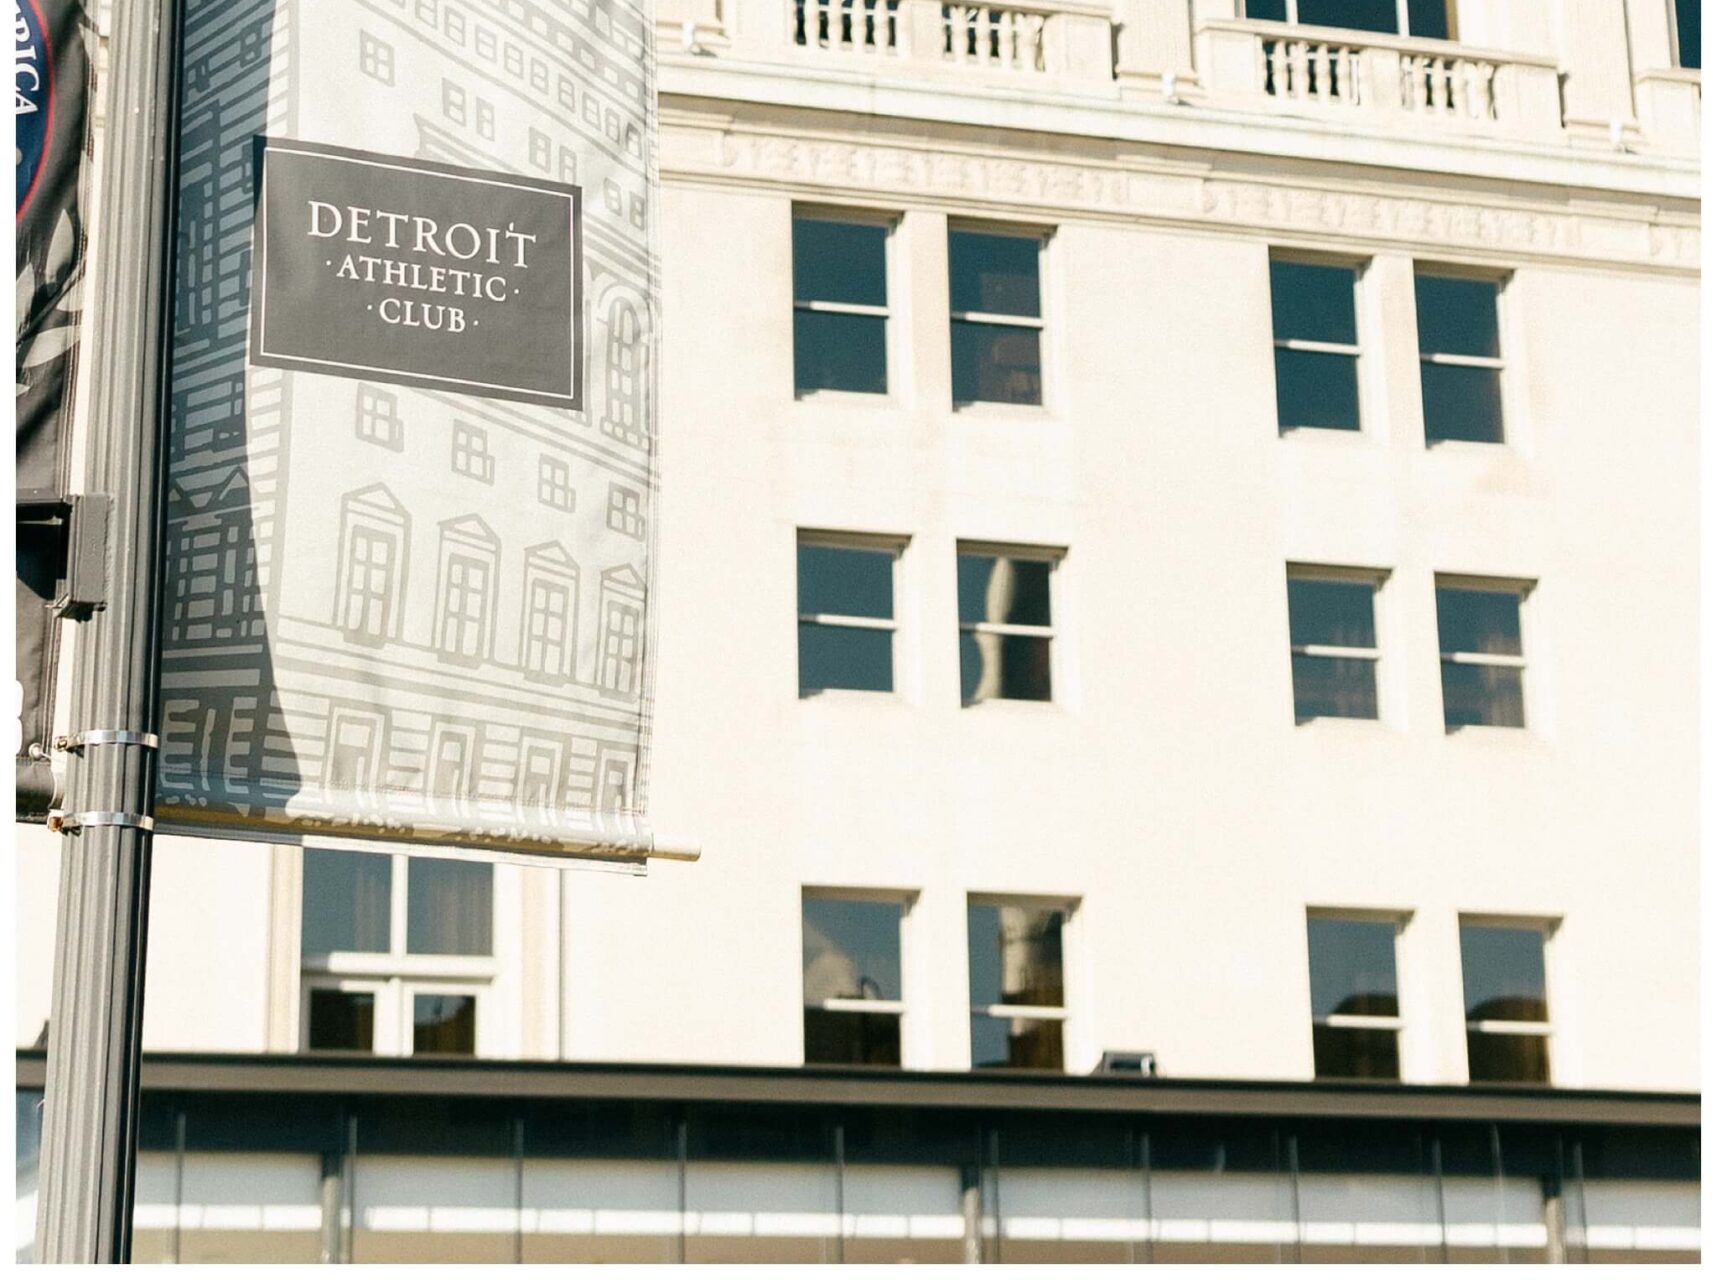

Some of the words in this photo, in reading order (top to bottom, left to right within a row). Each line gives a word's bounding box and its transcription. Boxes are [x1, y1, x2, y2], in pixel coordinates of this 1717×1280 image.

[307, 200, 537, 269] DETROIT
[336, 253, 507, 302] ATHLETIC
[379, 297, 467, 333] CLUB
